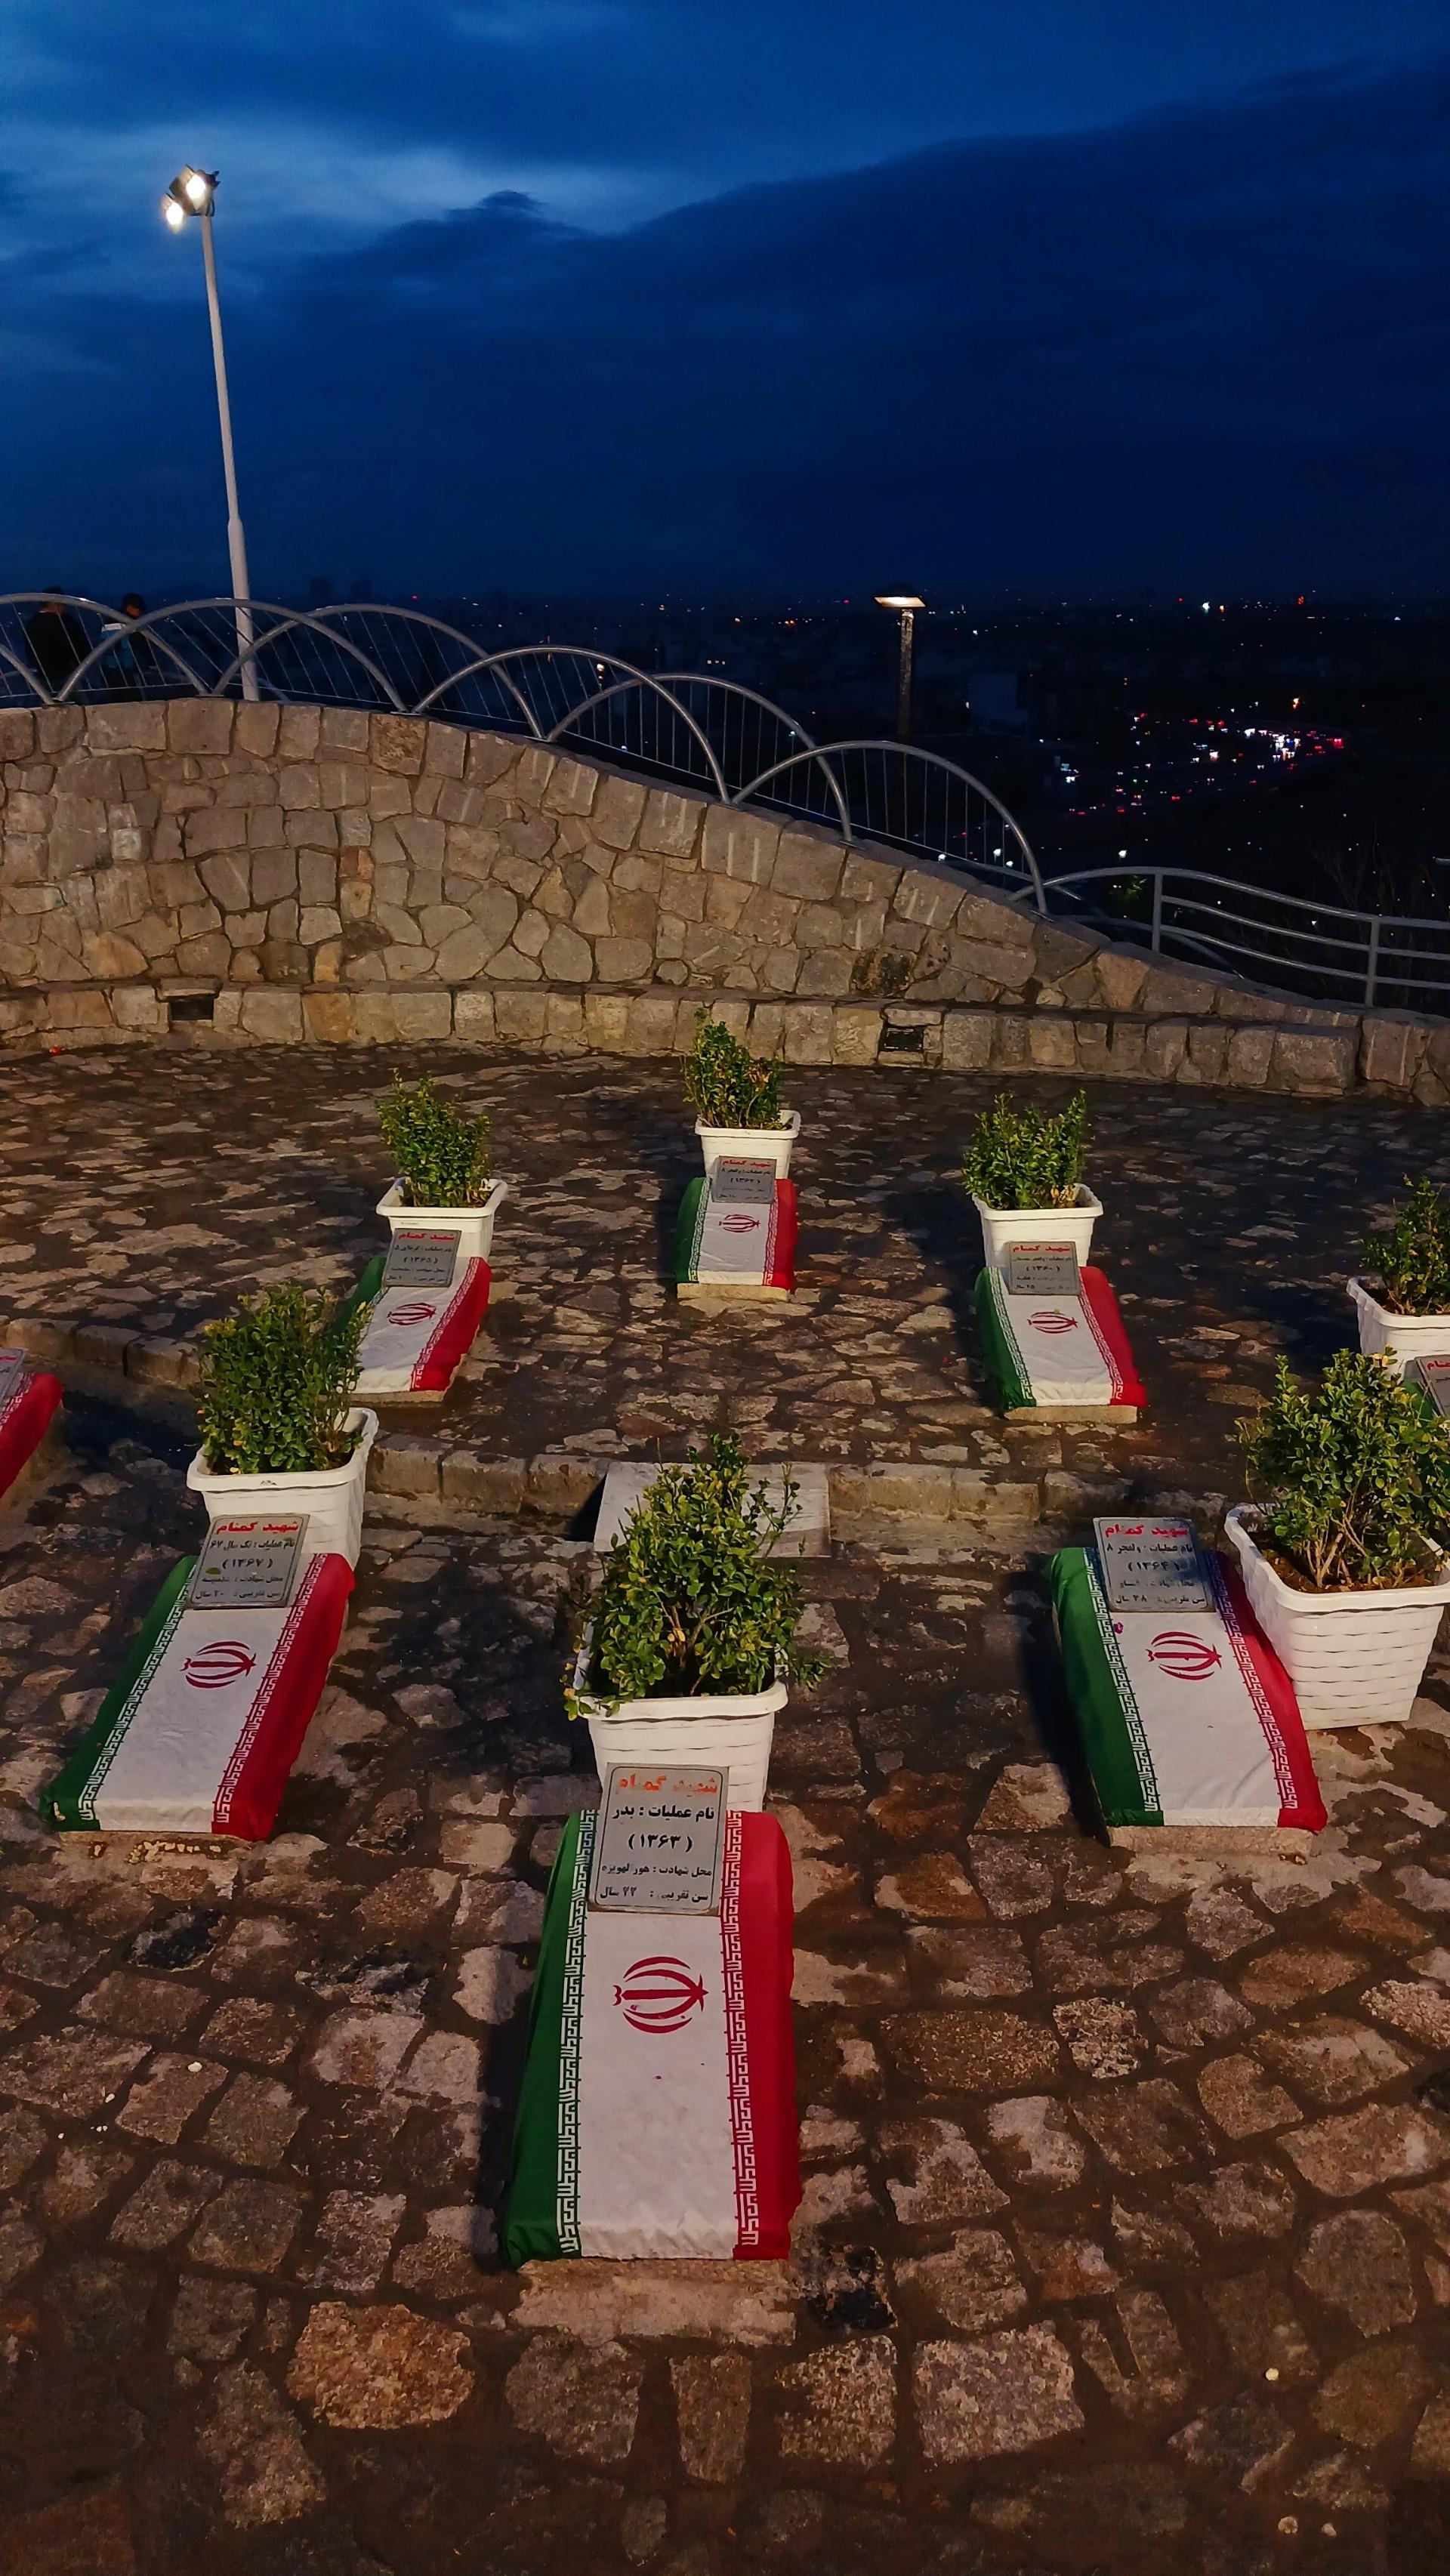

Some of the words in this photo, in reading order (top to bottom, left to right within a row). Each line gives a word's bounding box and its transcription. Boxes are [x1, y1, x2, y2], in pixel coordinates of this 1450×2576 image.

[263, 1521, 299, 1534] شهید
[1105, 1524, 1144, 1538] گمام
[1106, 1543, 1113, 1551] ۸
[615, 1773, 667, 1794] گمام
[612, 1805, 635, 1819] بدر
[648, 1804, 692, 1821] عملیات
[695, 1806, 714, 1822] نام
[628, 1834, 693, 1853] (۱۳۶۳)
[633, 1865, 650, 1875] هور
[659, 1865, 689, 1877] شهادت
[692, 1866, 712, 1877] محل
[600, 1886, 619, 1899] سال
[692, 1893, 708, 1903] سن
